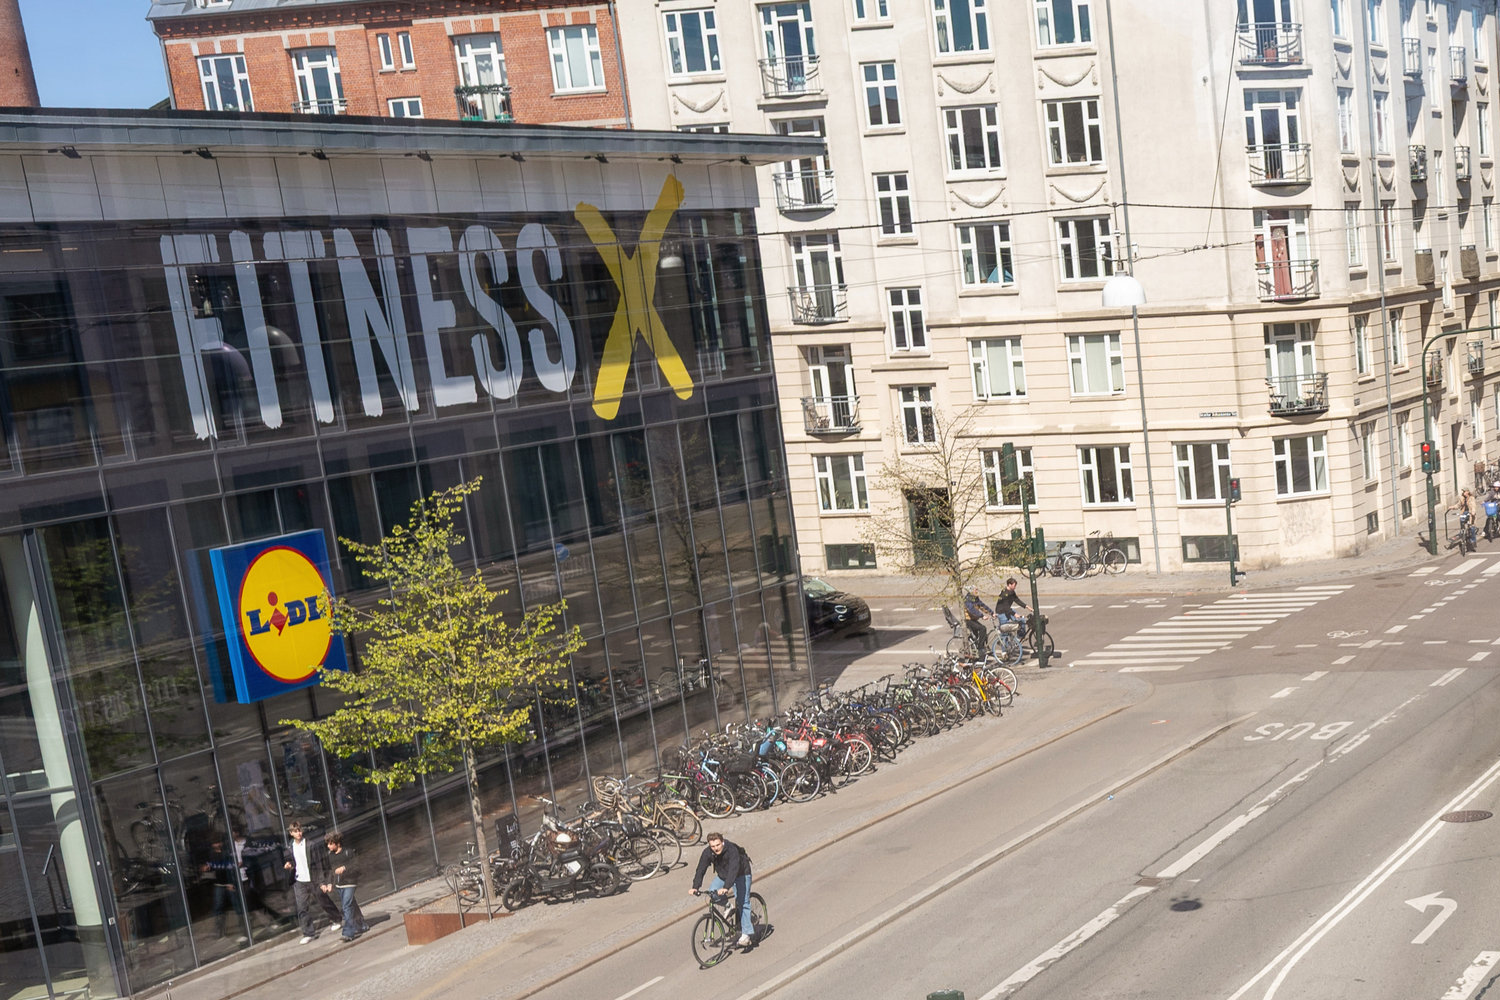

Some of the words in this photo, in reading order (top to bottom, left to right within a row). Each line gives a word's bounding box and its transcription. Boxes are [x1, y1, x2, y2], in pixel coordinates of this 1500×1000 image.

[160, 223, 577, 441] FITNESS
[574, 173, 695, 421] X
[1243, 720, 1354, 742] BUS
